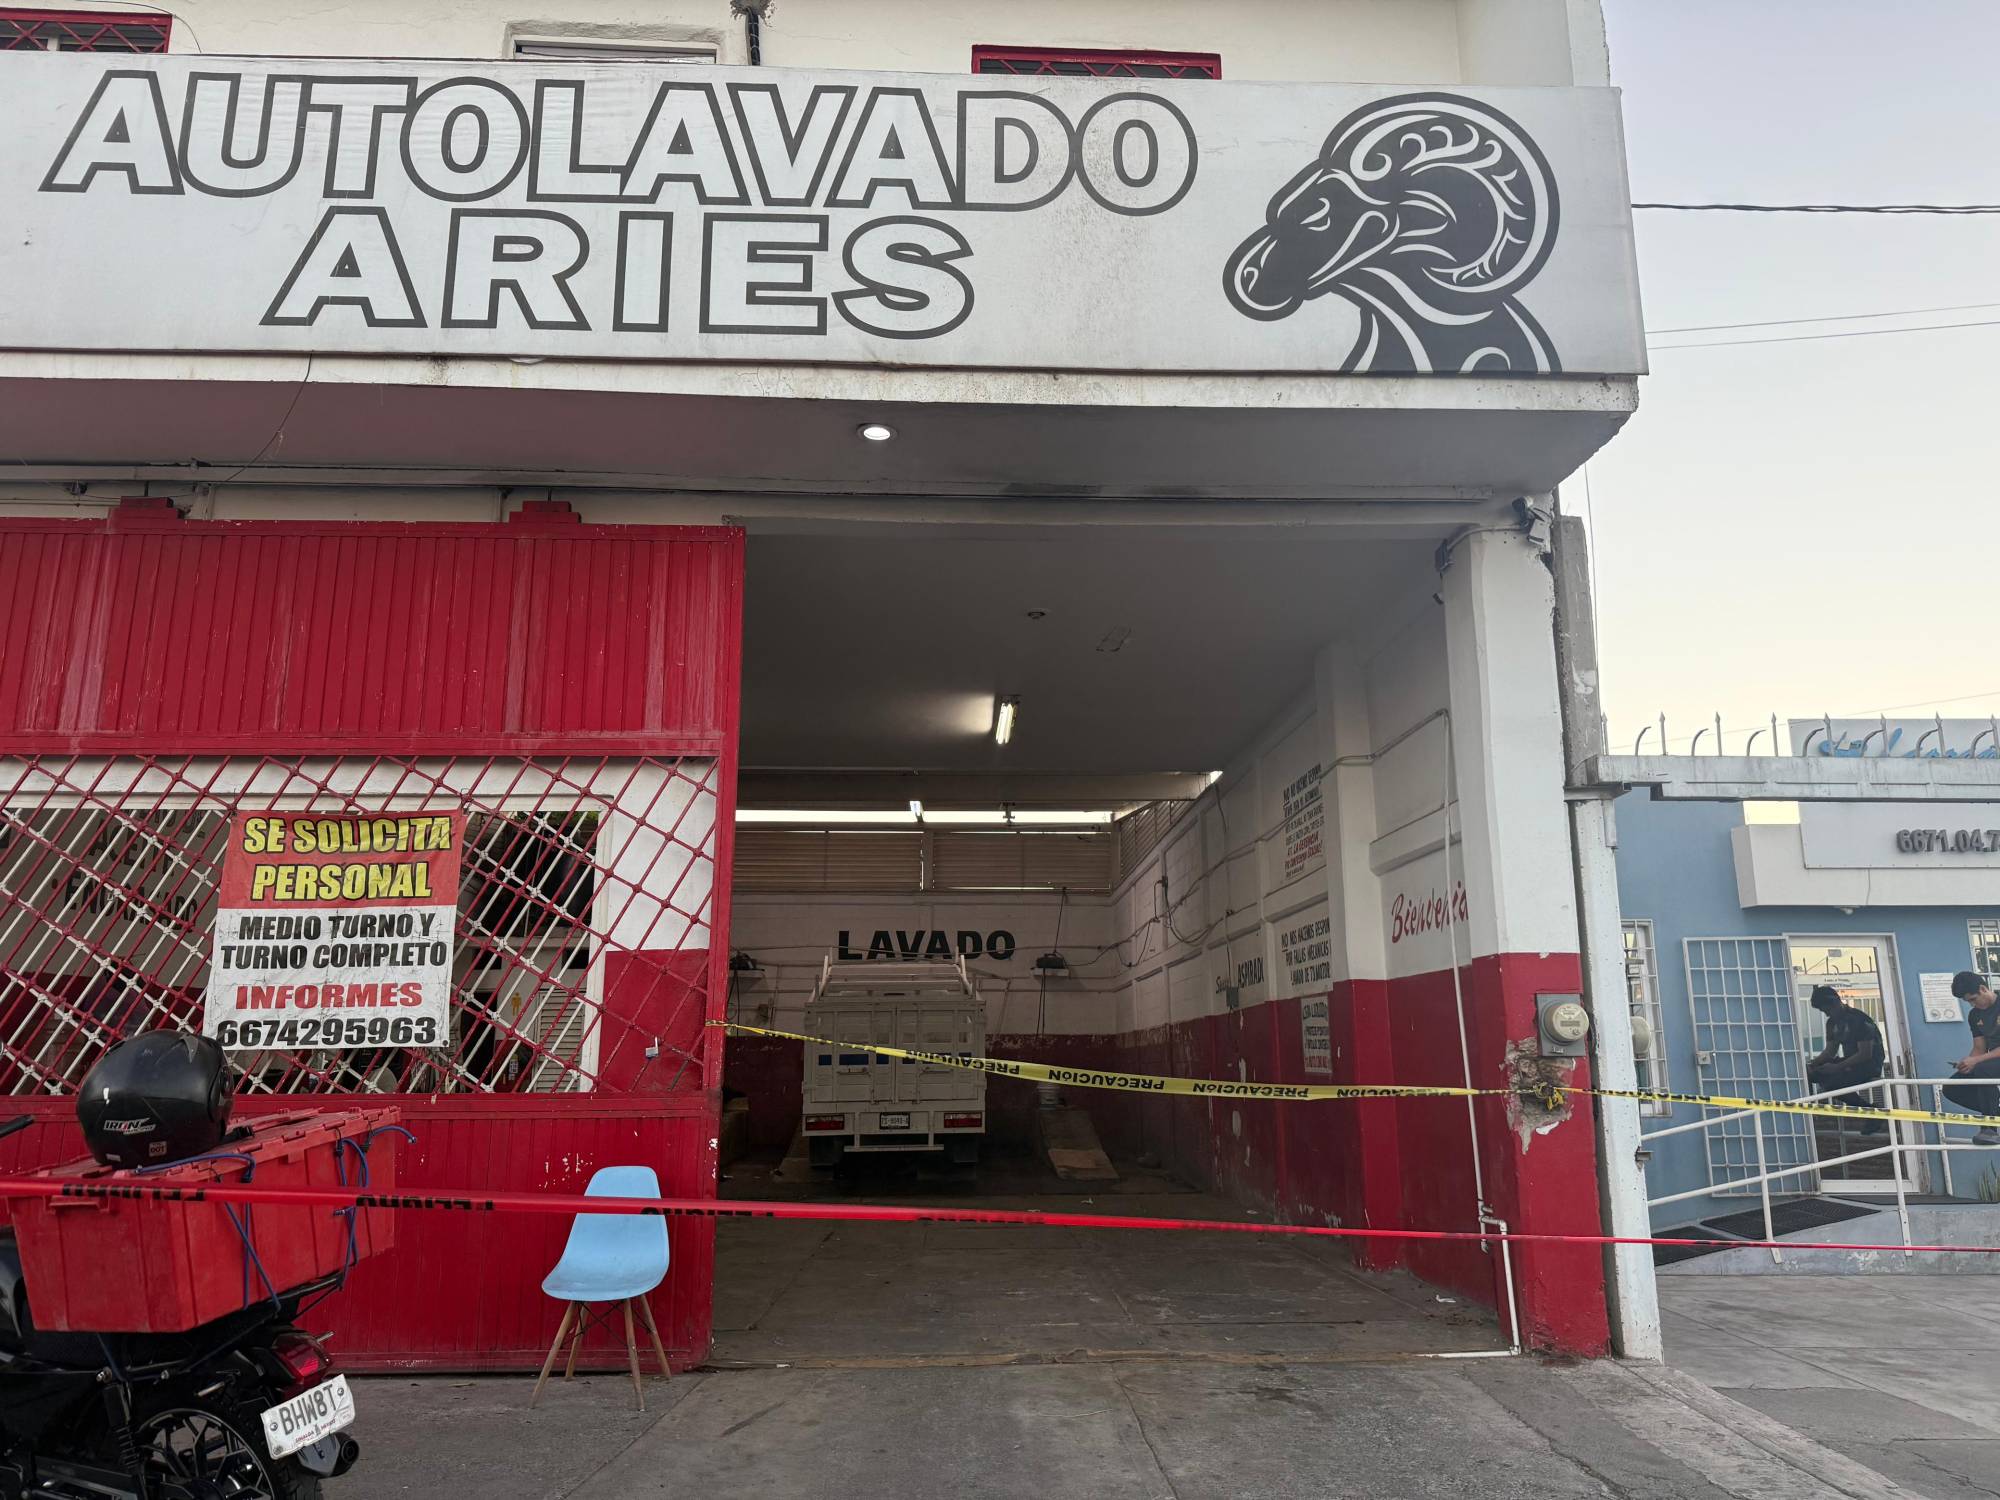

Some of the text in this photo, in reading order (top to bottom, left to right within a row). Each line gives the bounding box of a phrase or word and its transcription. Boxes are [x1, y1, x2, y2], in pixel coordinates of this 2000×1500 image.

[39, 69, 1198, 216] AUTOLAVADO
[259, 206, 975, 340] ARIES
[243, 816, 286, 853] SE
[293, 815, 452, 853] SOLICITA
[251, 861, 433, 901] PERSONAL
[239, 913, 436, 940] MEDIO TURNO Y
[221, 941, 448, 969] TURNO COMPLETO
[839, 930, 1016, 961] LAVADO
[235, 982, 423, 1009] INFORMES
[217, 1017, 436, 1047] 6674295963
[279, 1384, 336, 1435] BHW8T
